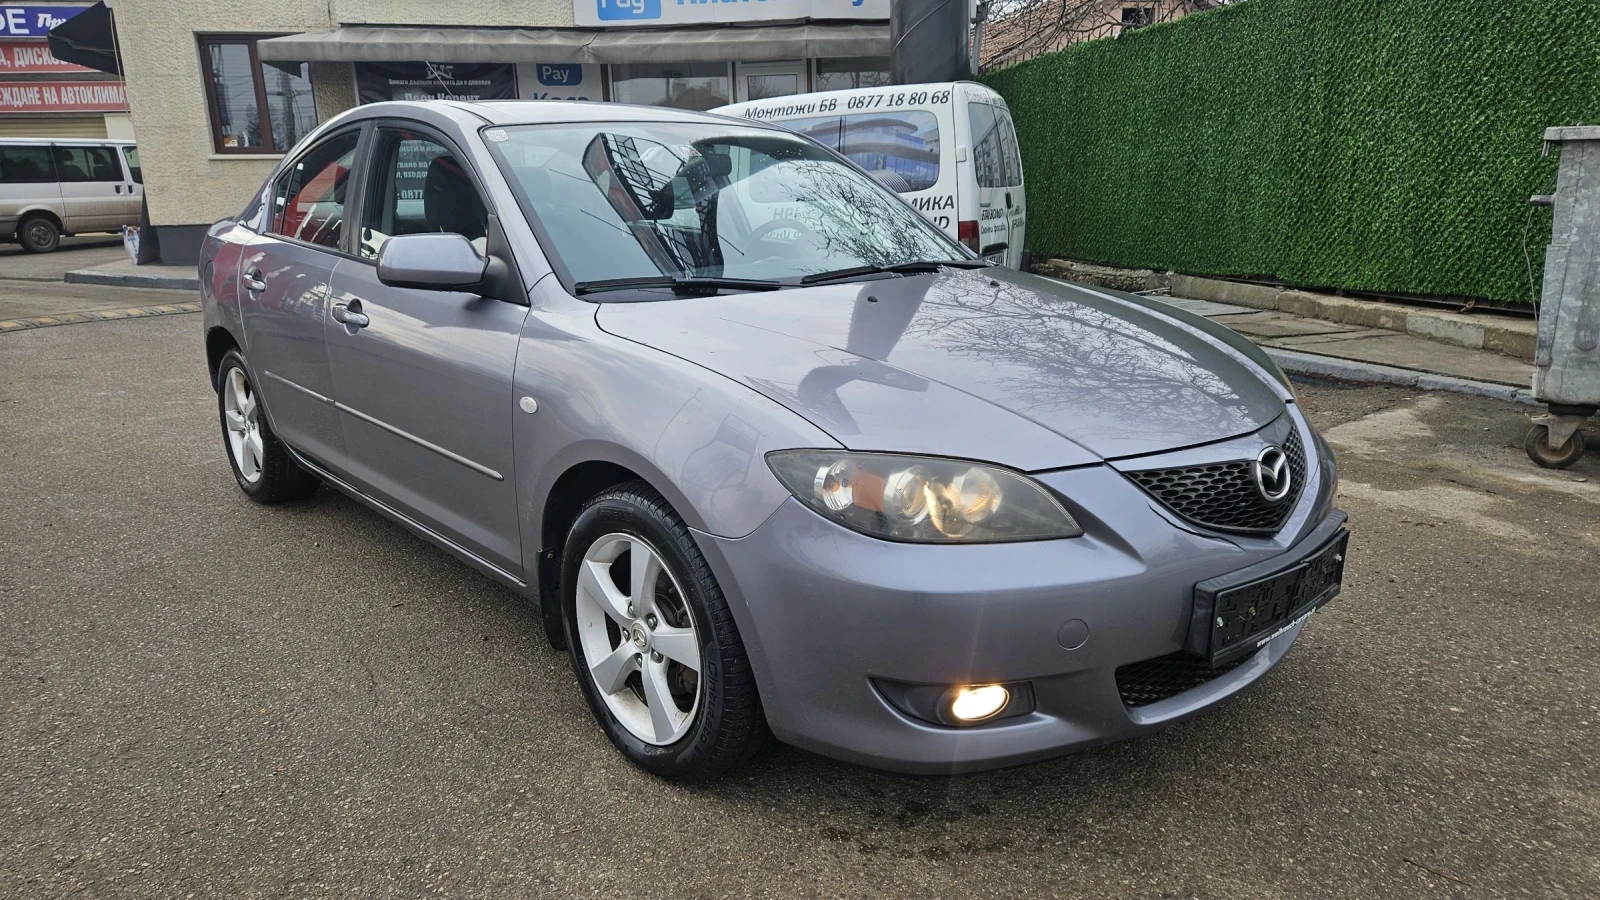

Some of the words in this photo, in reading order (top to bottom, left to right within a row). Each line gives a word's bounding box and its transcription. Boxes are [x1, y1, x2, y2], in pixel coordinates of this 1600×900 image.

[542, 65, 569, 83] Pay
[0, 86, 42, 107] ЖДАНЕ
[43, 87, 59, 104] НА
[61, 86, 126, 104] АВТОКЛИМА
[744, 101, 815, 119] Монтажи
[819, 98, 837, 112] БВ
[847, 94, 884, 110] 0877
[886, 93, 906, 107] 18
[908, 92, 928, 105] 80
[931, 90, 951, 104] 68
[401, 189, 423, 199] 0877
